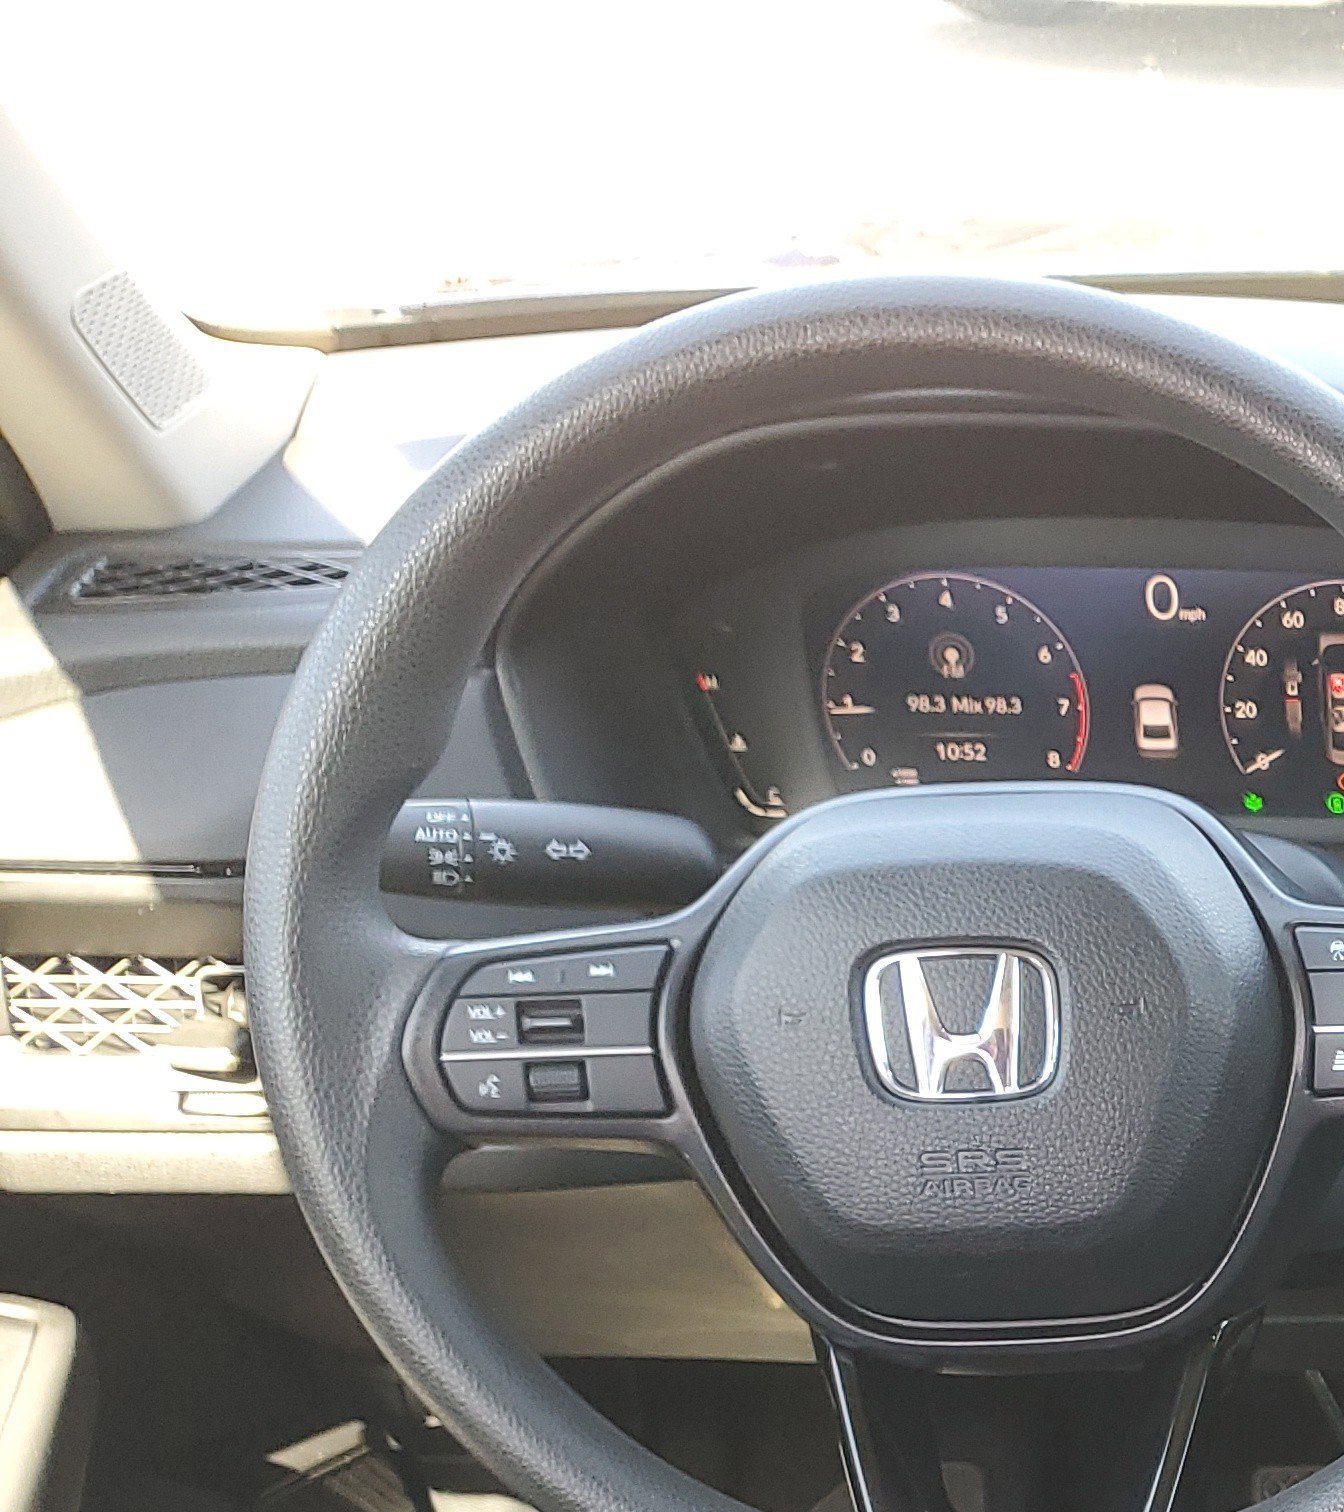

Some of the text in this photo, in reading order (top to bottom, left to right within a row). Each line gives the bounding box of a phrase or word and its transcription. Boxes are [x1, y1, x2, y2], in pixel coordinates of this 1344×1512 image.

[938, 590, 953, 608] 4
[1144, 574, 1206, 623] 0 mph
[886, 603, 900, 623] 3
[994, 604, 1009, 625] 5
[1282, 611, 1304, 629] 60
[850, 641, 866, 663] 2
[1038, 645, 1051, 665] 6
[1244, 649, 1268, 668] 40
[906, 695, 1023, 715] 98.3 Mix 98.3
[1057, 697, 1069, 717] 7
[1234, 702, 1258, 720] 20
[860, 746, 876, 766] 0
[935, 742, 988, 762] 10:52
[1045, 749, 1061, 769] 8
[415, 826, 460, 843] AUTO
[919, 1148, 1027, 1174] SRS
